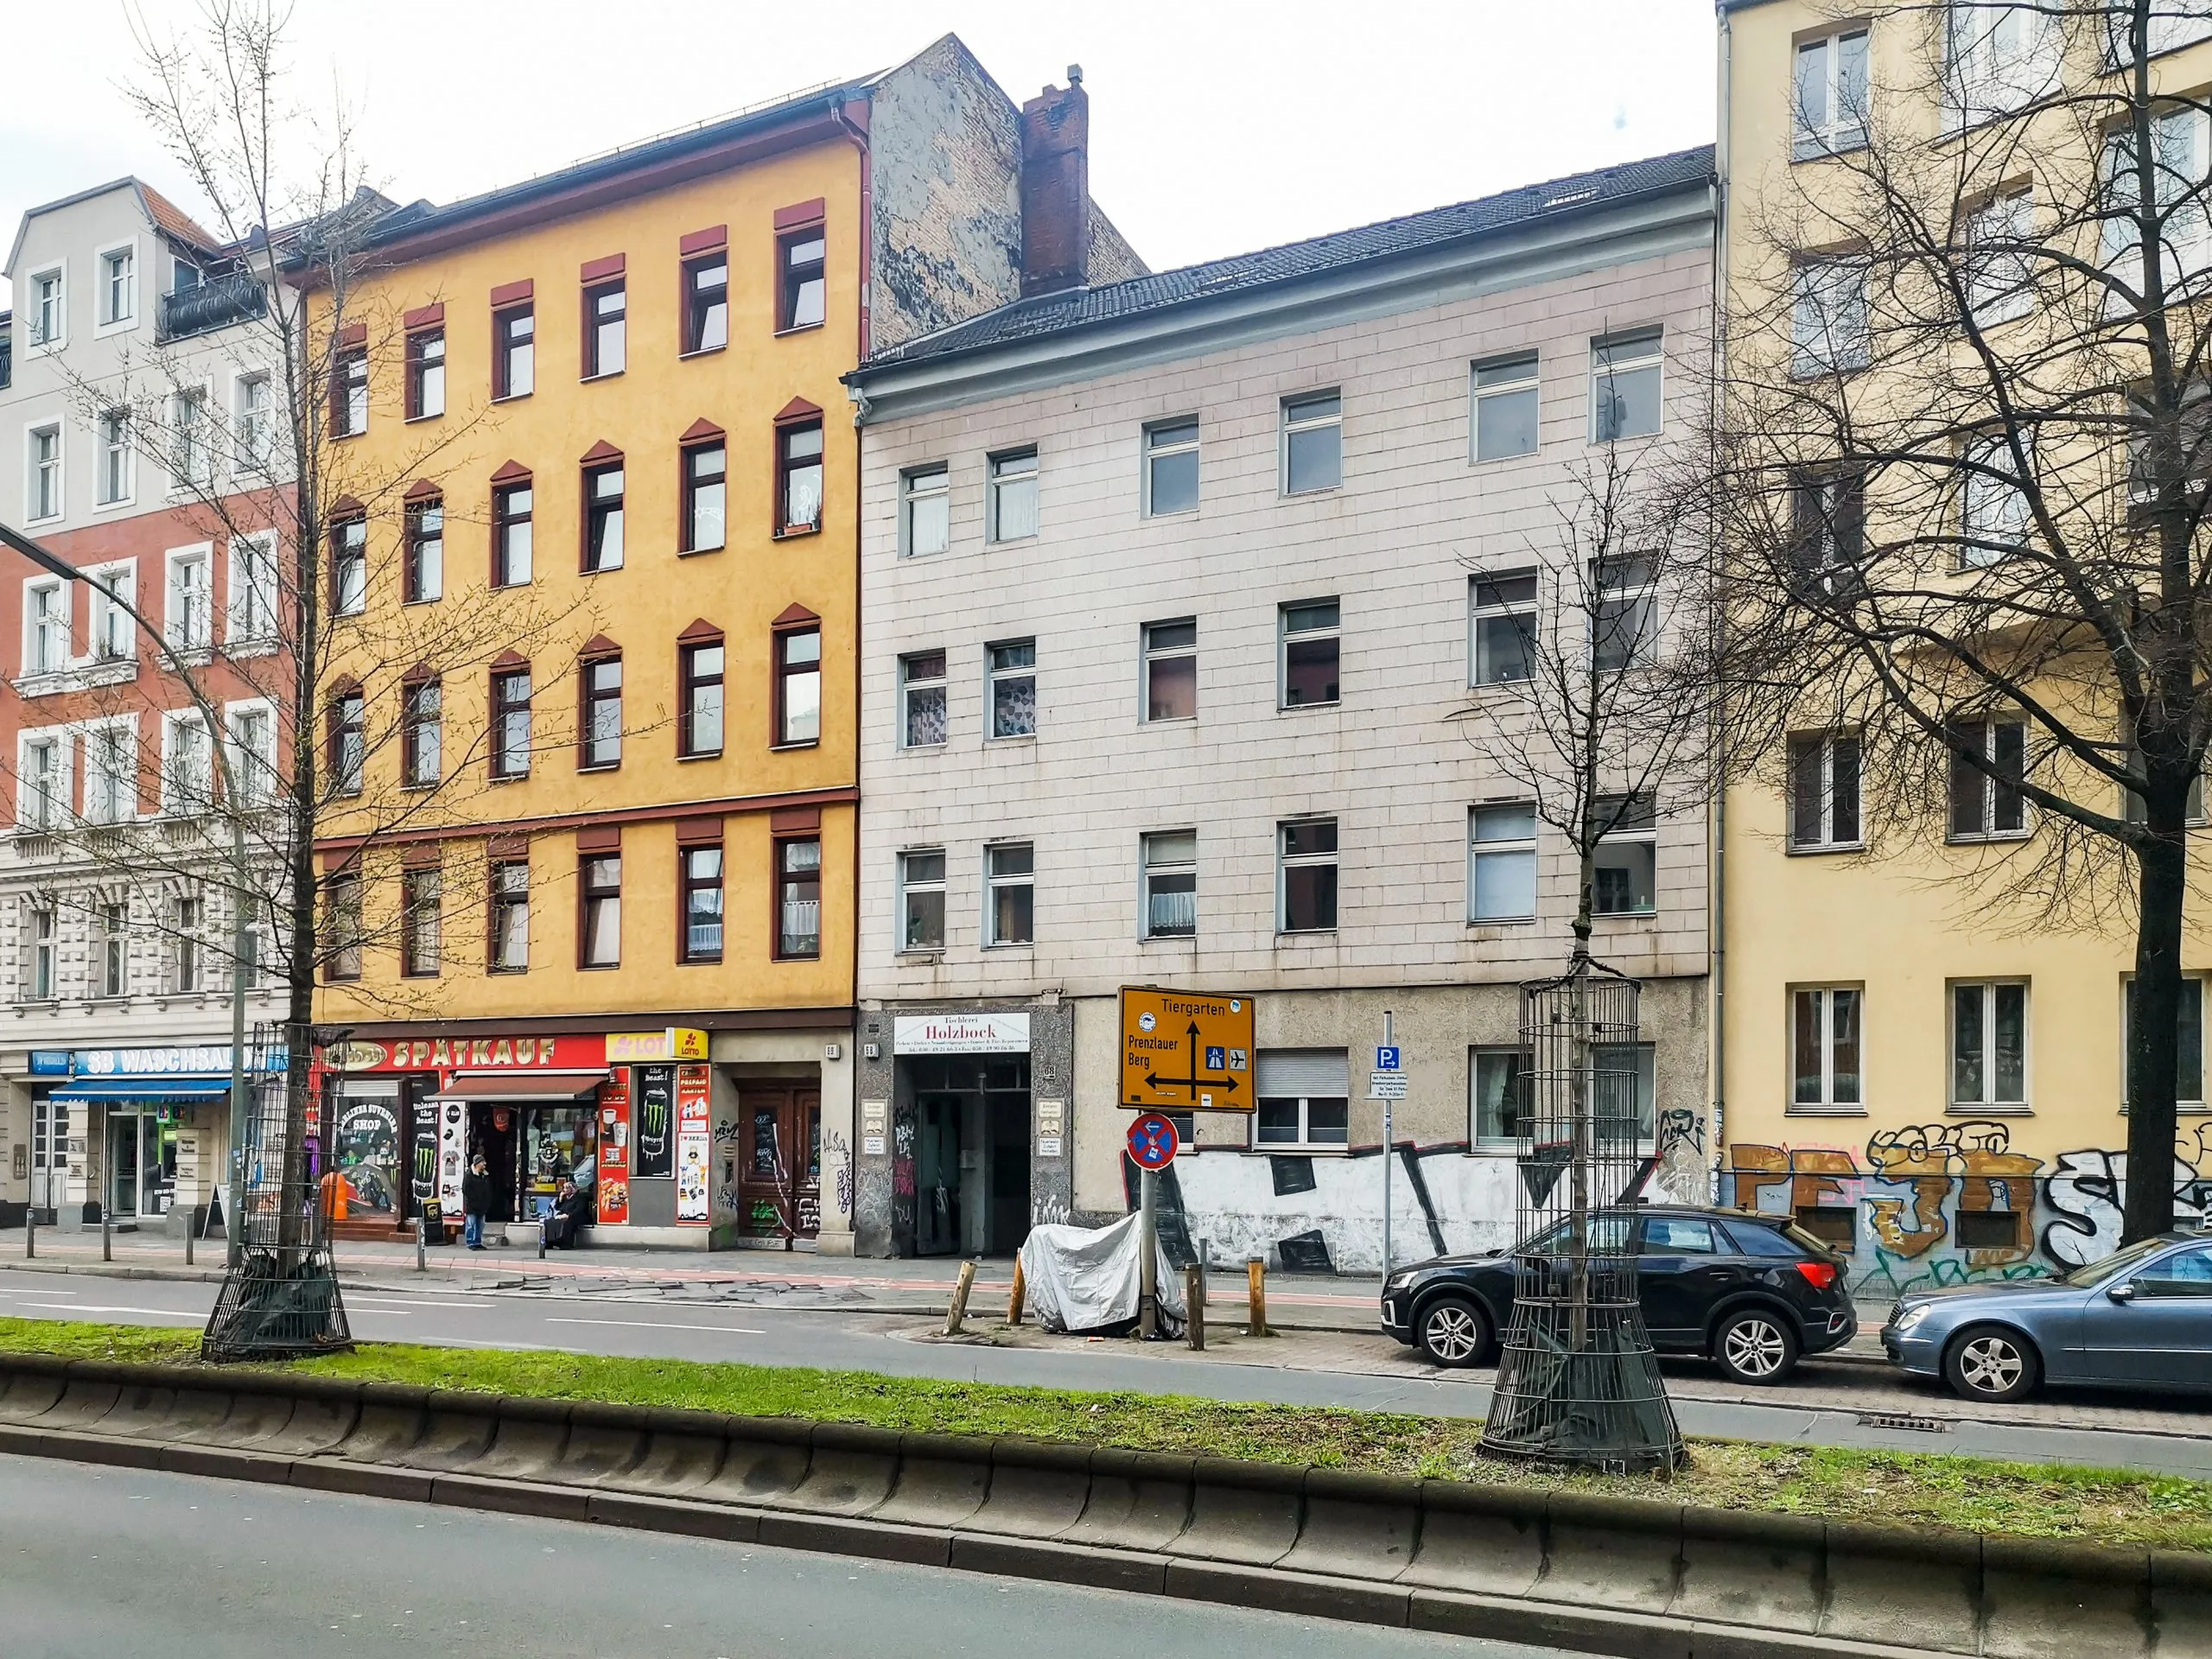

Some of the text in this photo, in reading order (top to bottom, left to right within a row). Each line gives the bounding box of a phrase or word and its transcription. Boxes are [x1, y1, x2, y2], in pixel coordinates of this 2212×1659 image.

[1161, 999, 1225, 1017] Tiergarten
[926, 1024, 996, 1039] Holzbock
[635, 1037, 665, 1054] LOT
[1128, 1034, 1178, 1050] Prenzlauer
[392, 1038, 555, 1066] SPÄTKAUF
[682, 1047, 700, 1056] LOTTO
[1380, 1049, 1393, 1067] P
[87, 1051, 115, 1074] SB
[1128, 1052, 1150, 1070] Berg
[353, 1120, 381, 1131] SHOP
